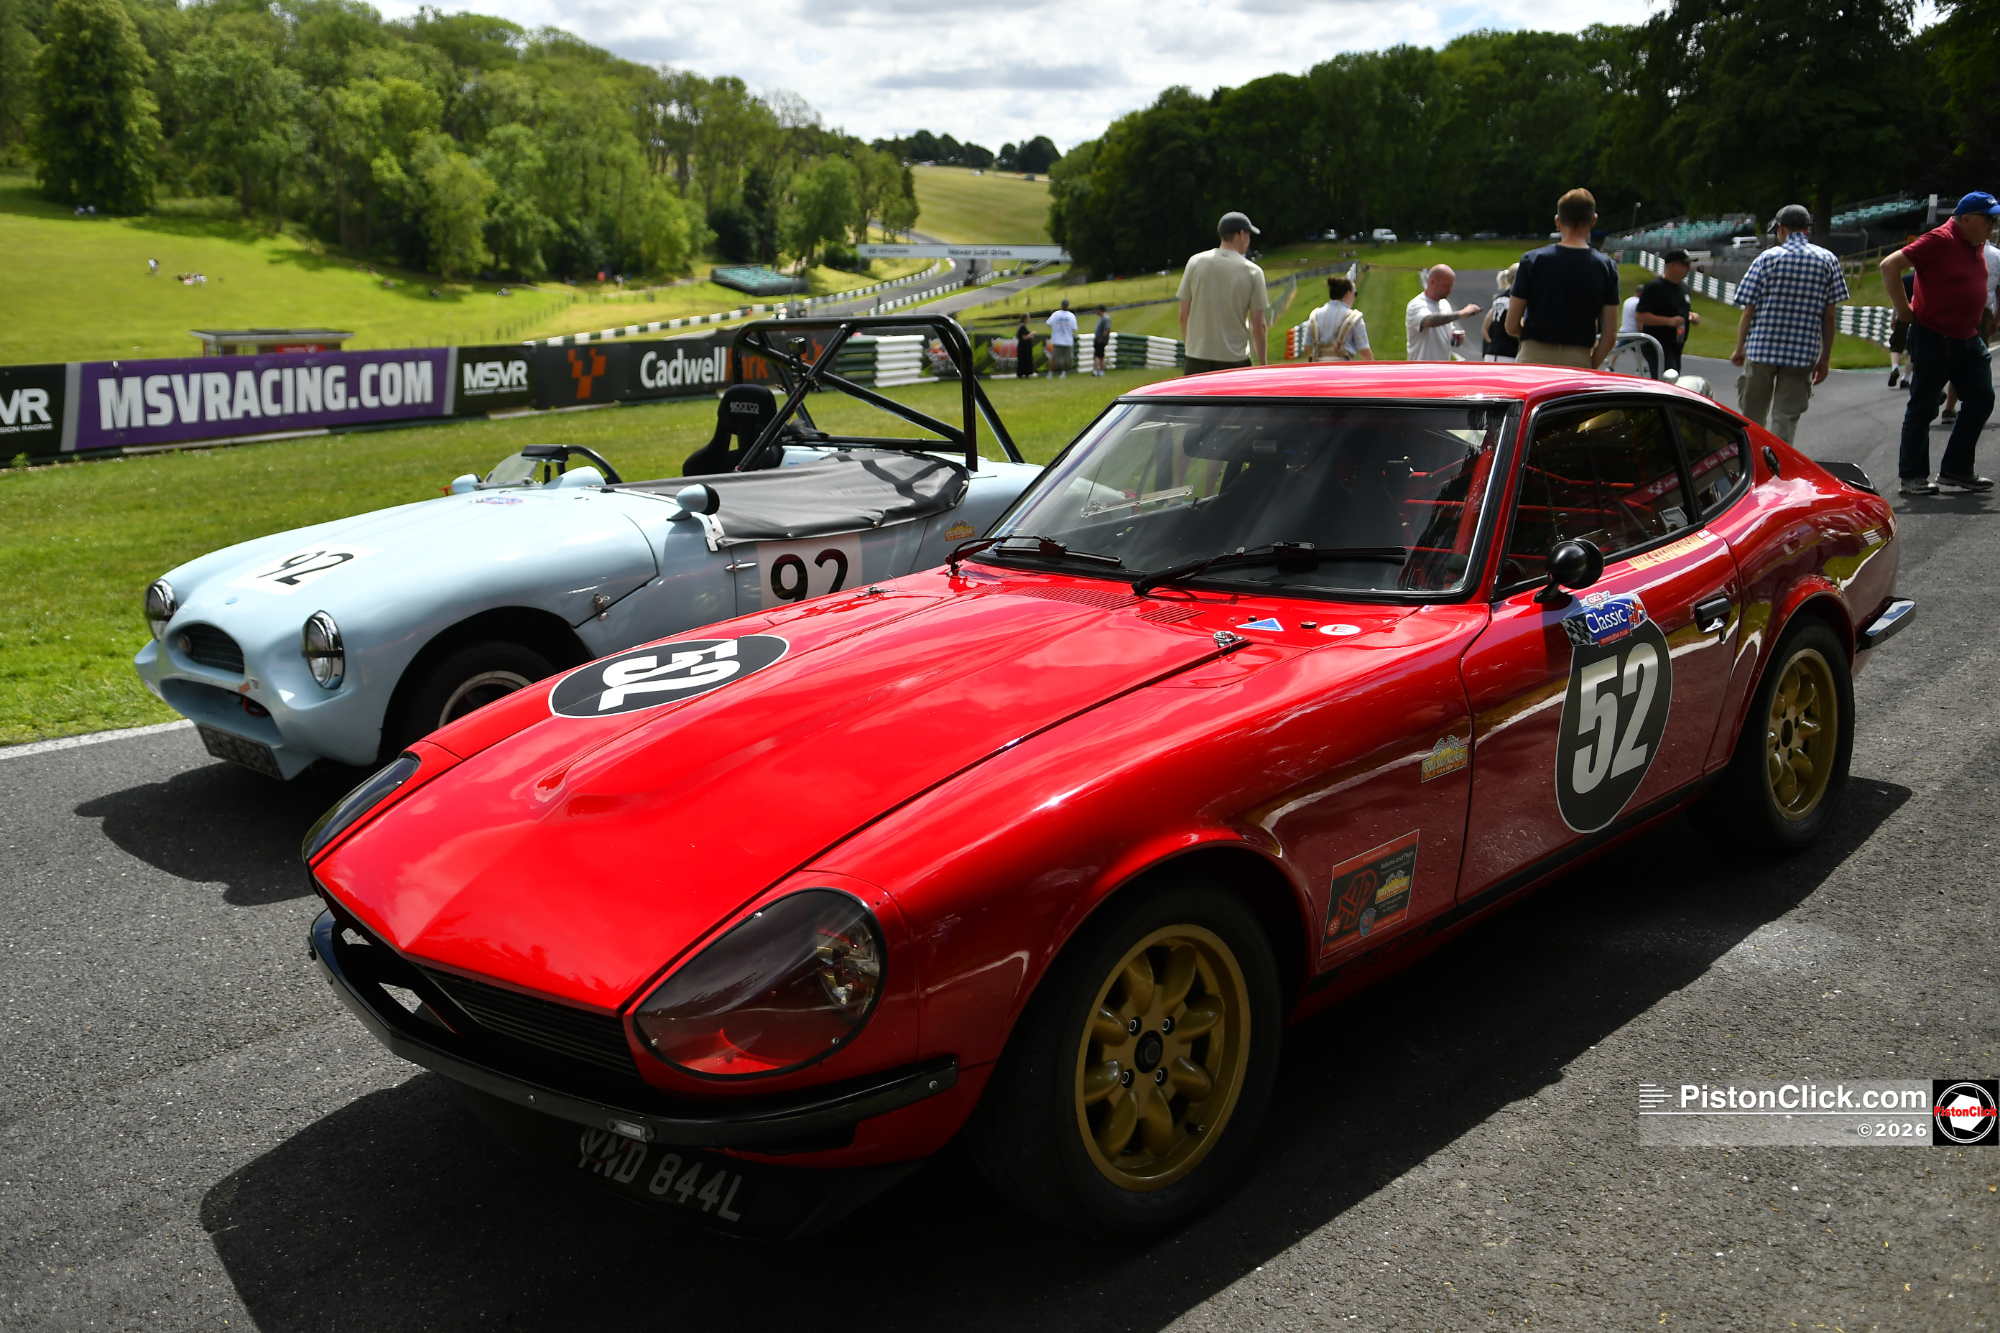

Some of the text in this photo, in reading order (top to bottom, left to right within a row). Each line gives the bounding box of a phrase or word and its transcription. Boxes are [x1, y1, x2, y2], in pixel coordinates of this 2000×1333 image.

[97, 361, 434, 431] MSVRACING.COM
[463, 360, 529, 389] MSVR
[22, 423, 53, 432] RACING
[256, 550, 355, 586] 92
[770, 548, 848, 603] 92
[1585, 606, 1628, 634] Classic
[1587, 594, 1603, 604] CSCC
[598, 639, 741, 711] 52
[1572, 642, 1659, 794] 52
[648, 1152, 743, 1222] 844L
